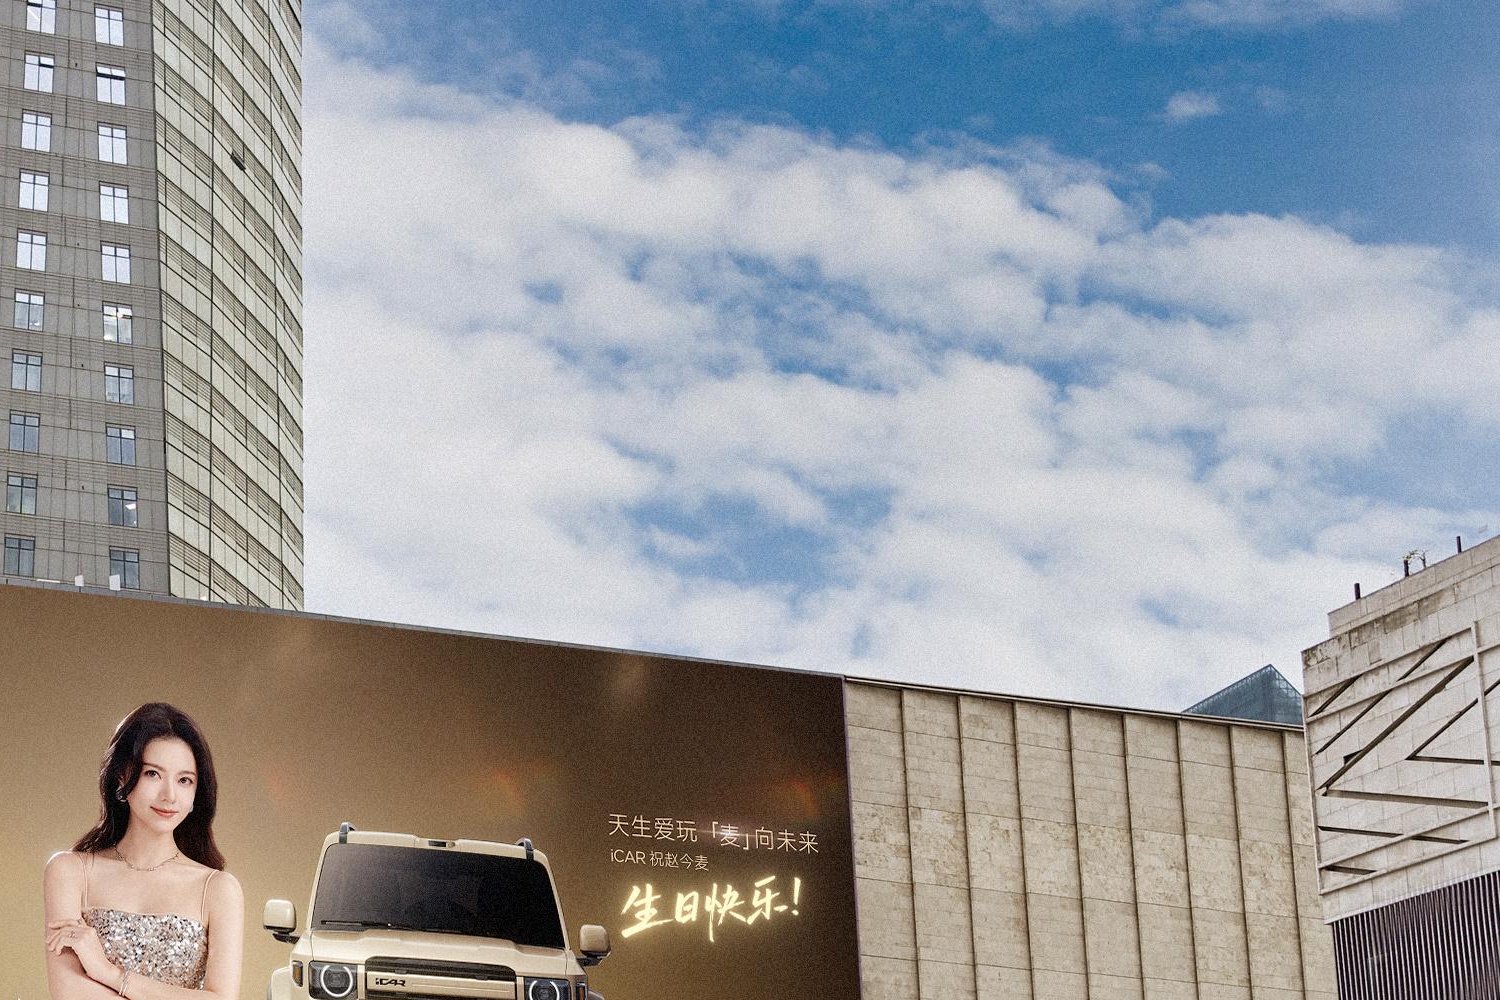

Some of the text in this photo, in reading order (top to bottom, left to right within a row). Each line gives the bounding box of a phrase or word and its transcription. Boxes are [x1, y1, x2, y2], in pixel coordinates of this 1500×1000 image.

[610, 849, 709, 871] iCAR 祝赵今麦
